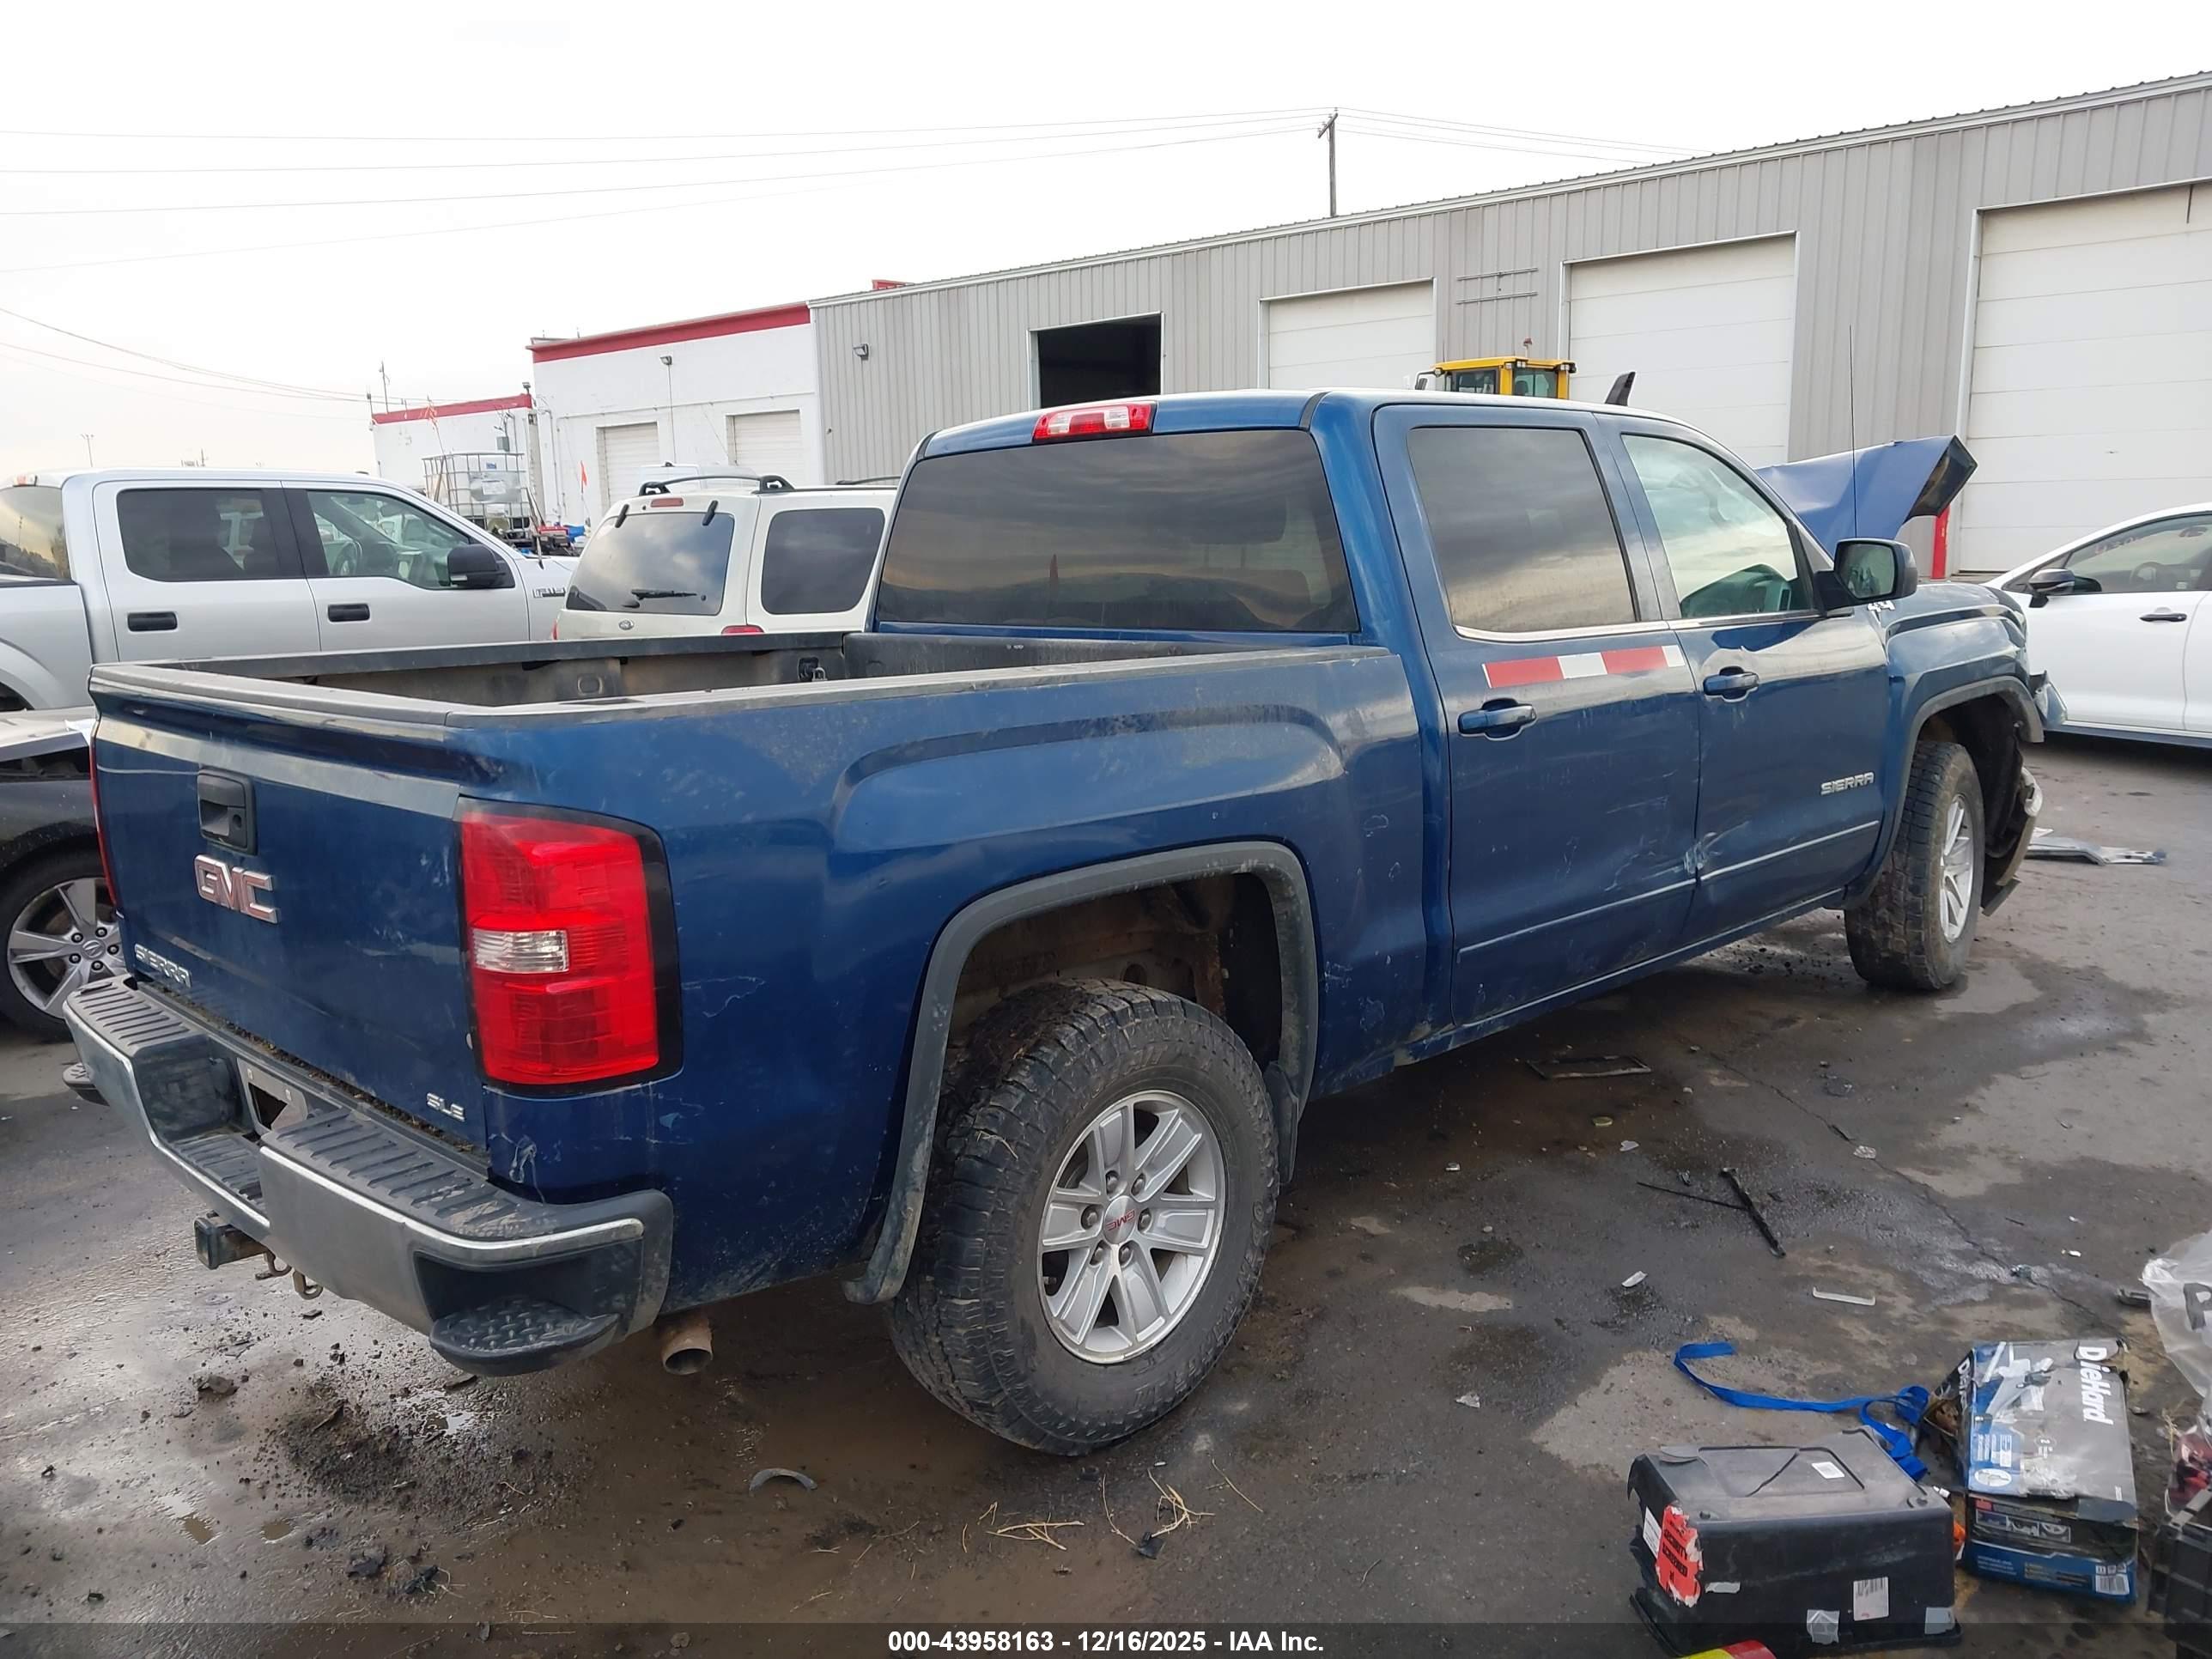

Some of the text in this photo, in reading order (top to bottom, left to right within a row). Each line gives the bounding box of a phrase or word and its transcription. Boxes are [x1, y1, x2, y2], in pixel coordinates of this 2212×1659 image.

[1820, 771, 1875, 795] SIERRA
[194, 854, 278, 924] GMC
[134, 943, 192, 988] SIERRA
[426, 1092, 465, 1122] SLE
[1106, 1208, 1135, 1231] GMC
[2077, 1346, 2114, 1425] DieHard
